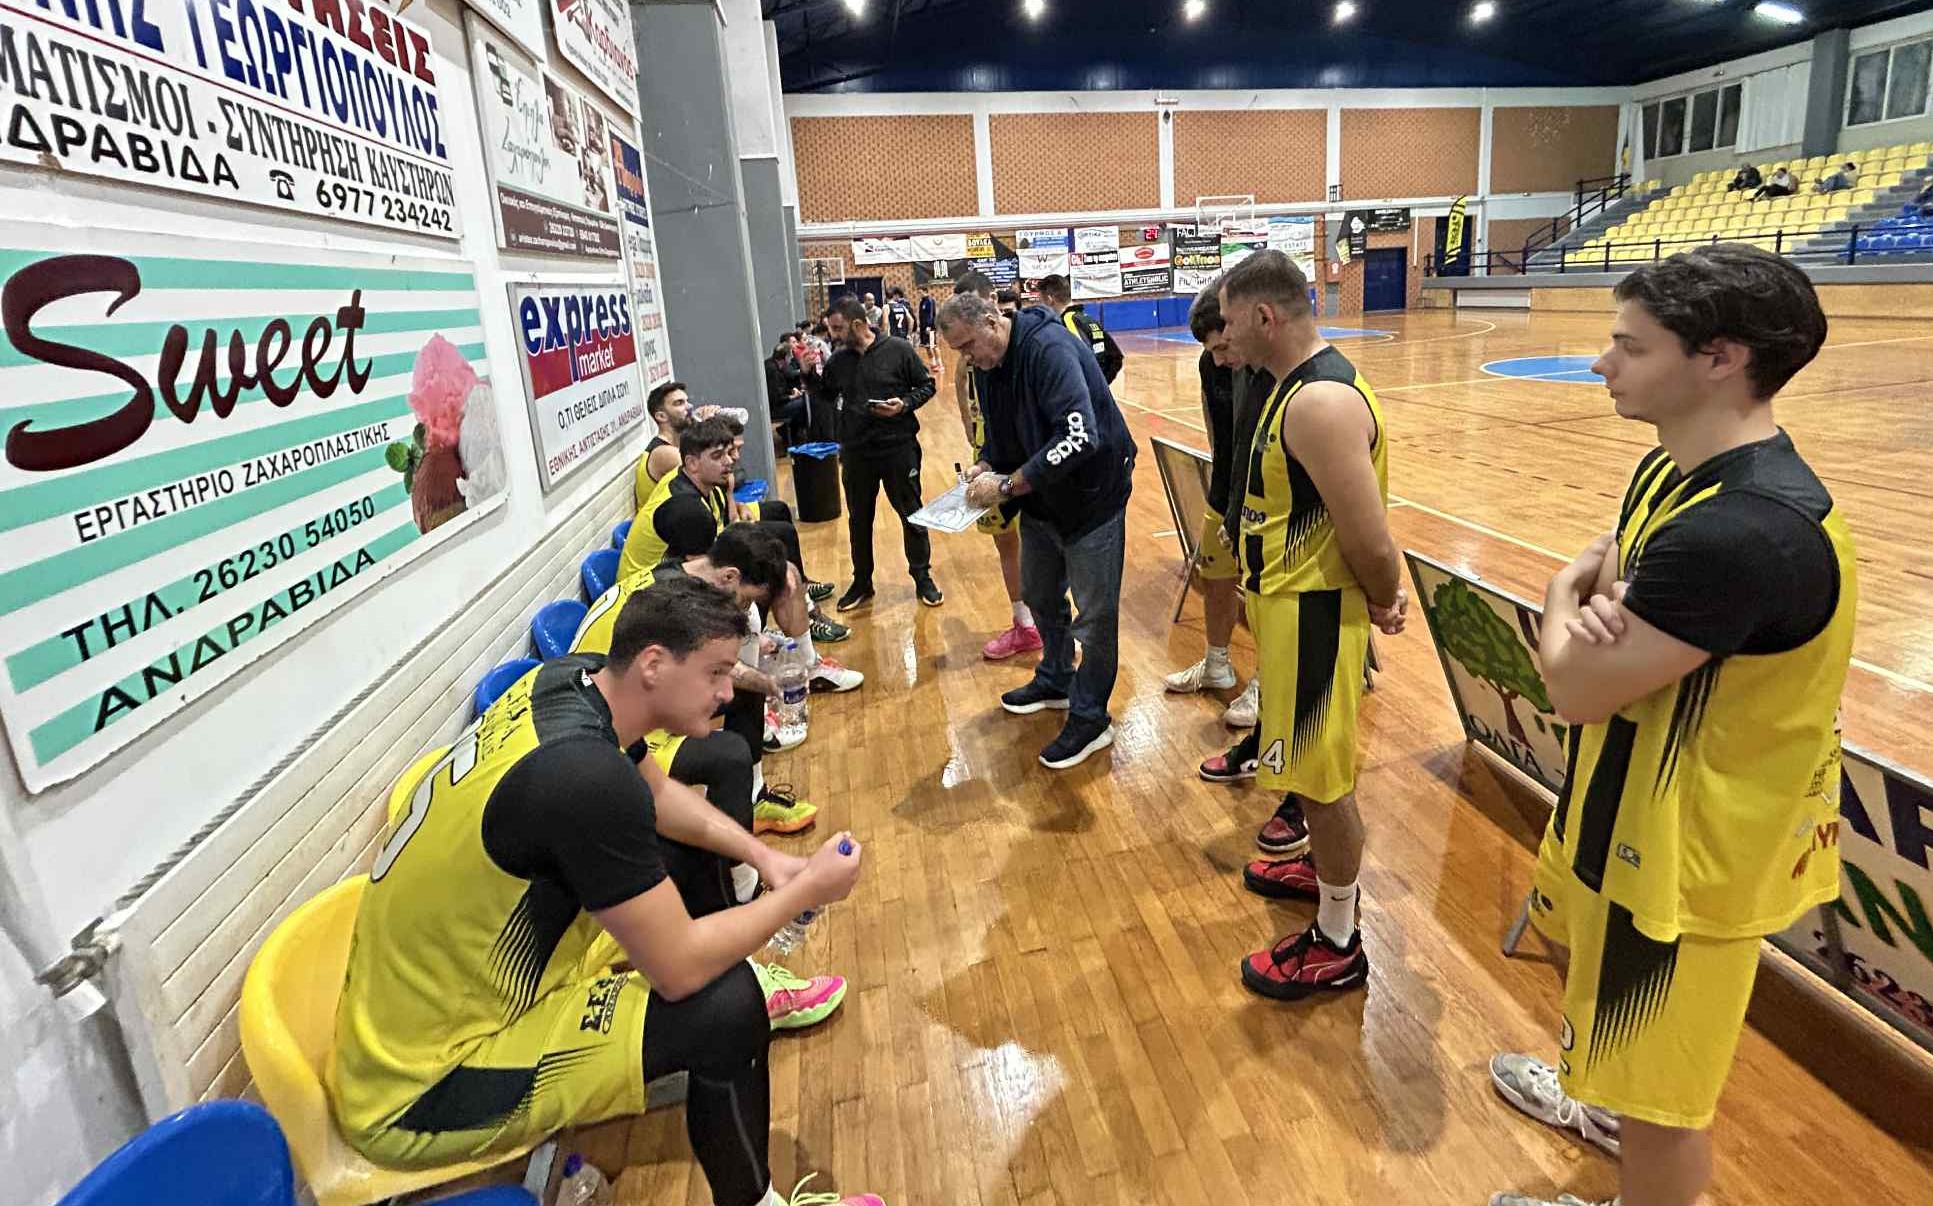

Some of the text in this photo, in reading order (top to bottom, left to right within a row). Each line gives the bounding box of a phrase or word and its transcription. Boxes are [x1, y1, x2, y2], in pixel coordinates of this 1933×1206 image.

[0, 103, 240, 191] ΔΡΑΒΙΔΑ
[217, 97, 362, 184] ΣΥΝΤΗΡΗΣΗ
[367, 151, 456, 207] ΚΑΥΣΤΗΡΩΝ
[316, 179, 454, 233] 6977 234242
[1145, 229, 1158, 240] 24
[519, 293, 631, 382] express
[895, 313, 905, 328] 7
[2, 254, 373, 472] Sweet
[578, 343, 615, 377] market
[574, 394, 599, 421] ΘΕΛΕΙΣ
[1046, 411, 1089, 466] adidas
[74, 422, 391, 543] ΕΡΓΑΣΤΗΡΙΟ ΖΑΧΑΡΟΠΛΑΣΤΙΚΗΣ
[62, 495, 376, 663] ΤΗΛ. 26230 54050
[92, 547, 377, 734] ΑΝΔΡΑΒΙΔΑ
[1261, 738, 1285, 775] 4
